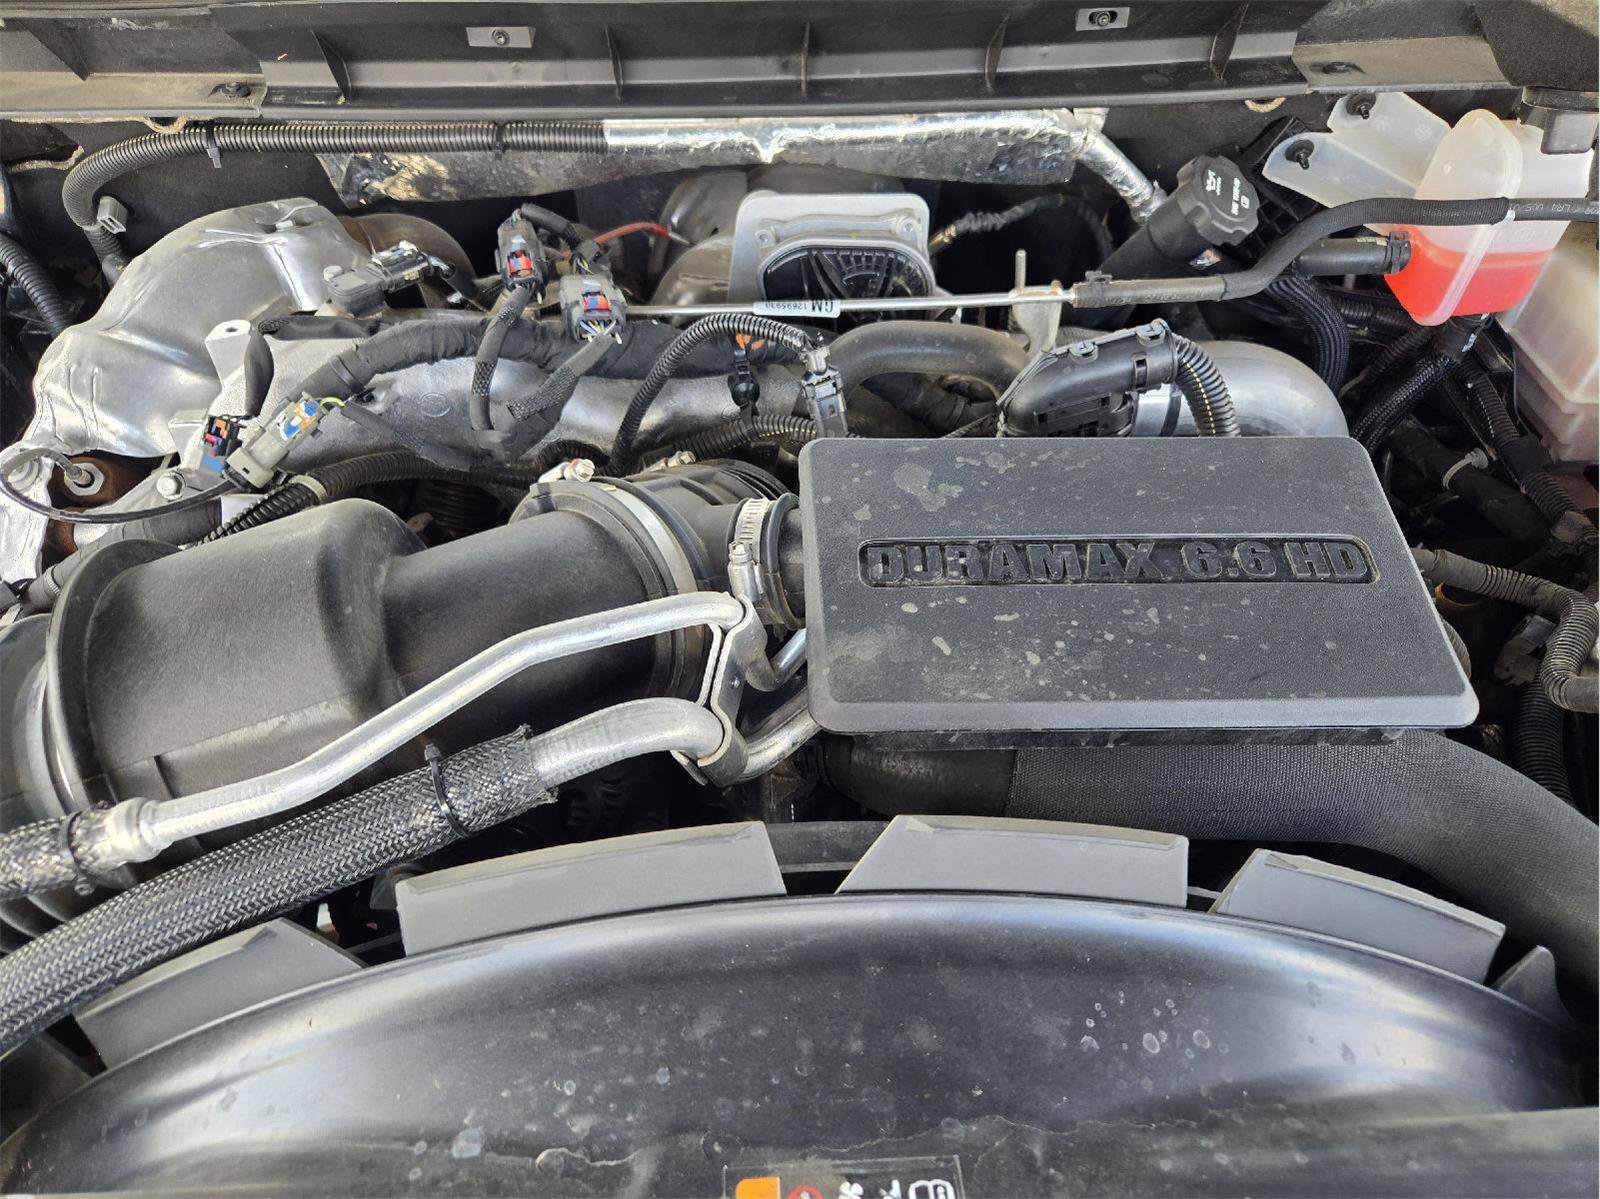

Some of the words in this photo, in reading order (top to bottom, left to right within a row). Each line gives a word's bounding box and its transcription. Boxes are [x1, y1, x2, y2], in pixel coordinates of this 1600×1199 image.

[812, 300, 834, 313] GM
[867, 542, 1162, 584] DURAMAX
[1180, 541, 1277, 579] 6.6
[1283, 541, 1369, 579] HD
